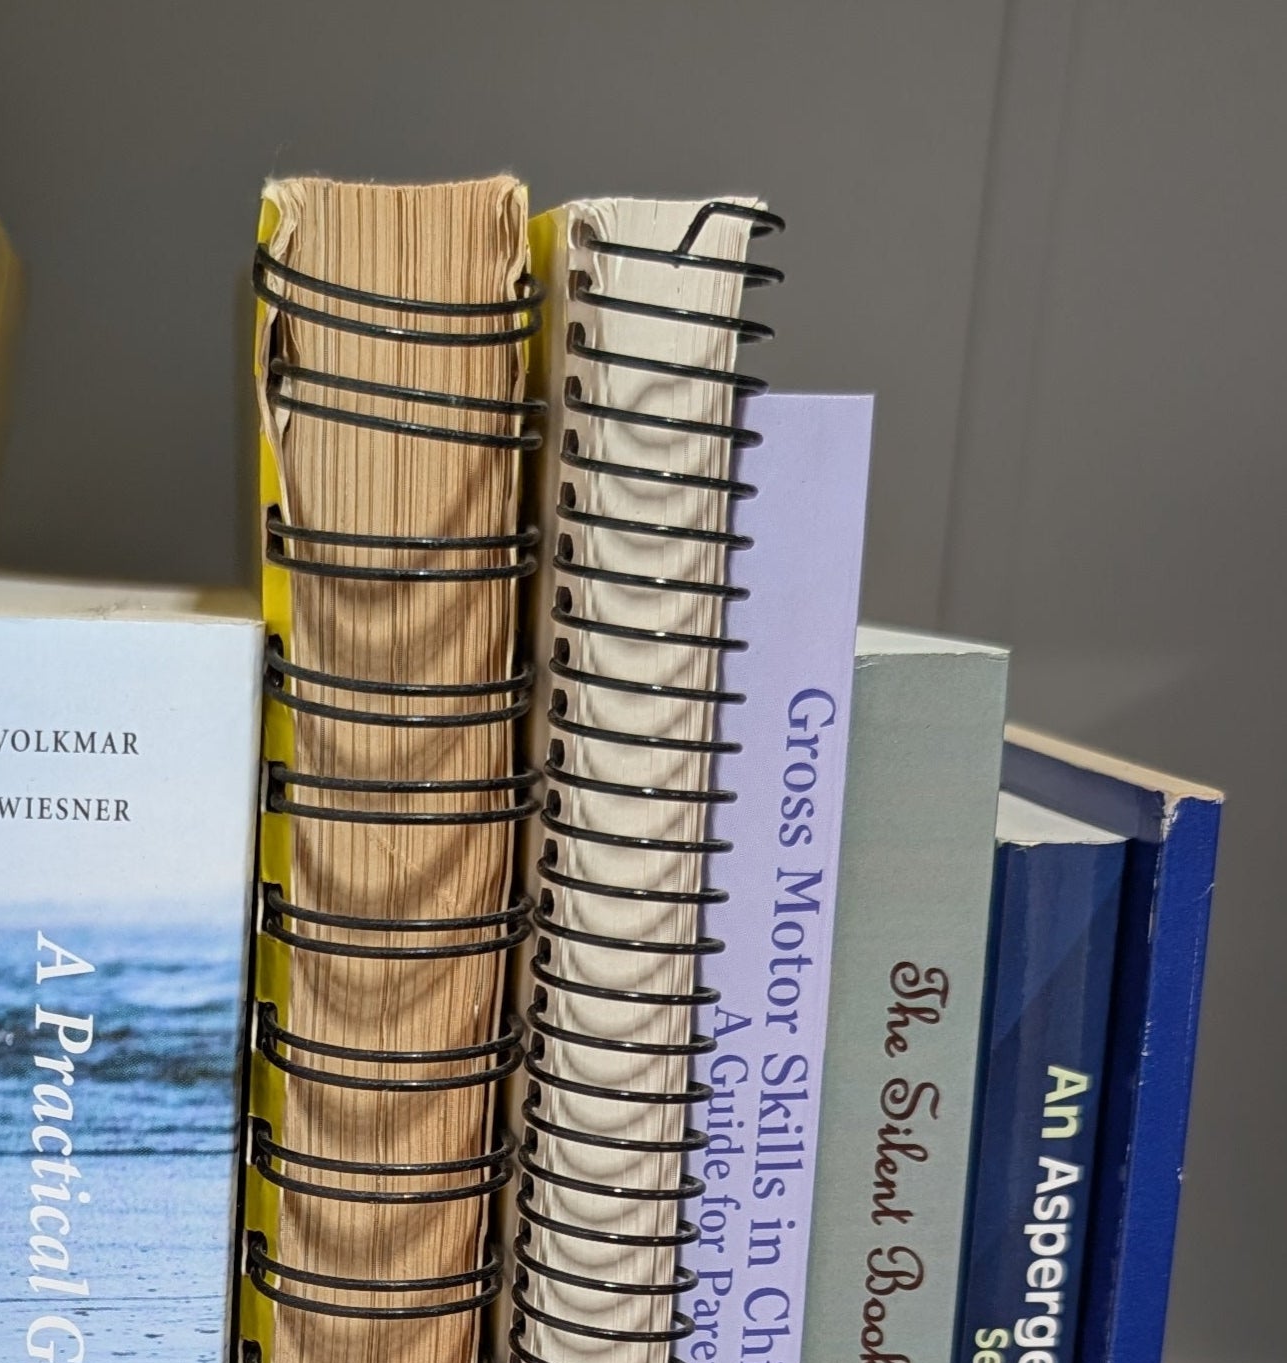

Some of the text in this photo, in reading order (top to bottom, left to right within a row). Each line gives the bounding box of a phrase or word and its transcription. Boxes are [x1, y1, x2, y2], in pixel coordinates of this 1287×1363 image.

[777, 688, 836, 849] Gross
[35, 930, 96, 985] A
[764, 868, 822, 1034] Motor
[714, 1005, 752, 1038] A
[884, 961, 949, 1058] The
[27, 1004, 93, 1298] Practical
[702, 1052, 750, 1179] Guide
[751, 1051, 809, 1199] Skills
[871, 1078, 940, 1226] Silent
[1041, 1065, 1091, 1140] An
[697, 1192, 740, 1250] for
[747, 1218, 795, 1269] in
